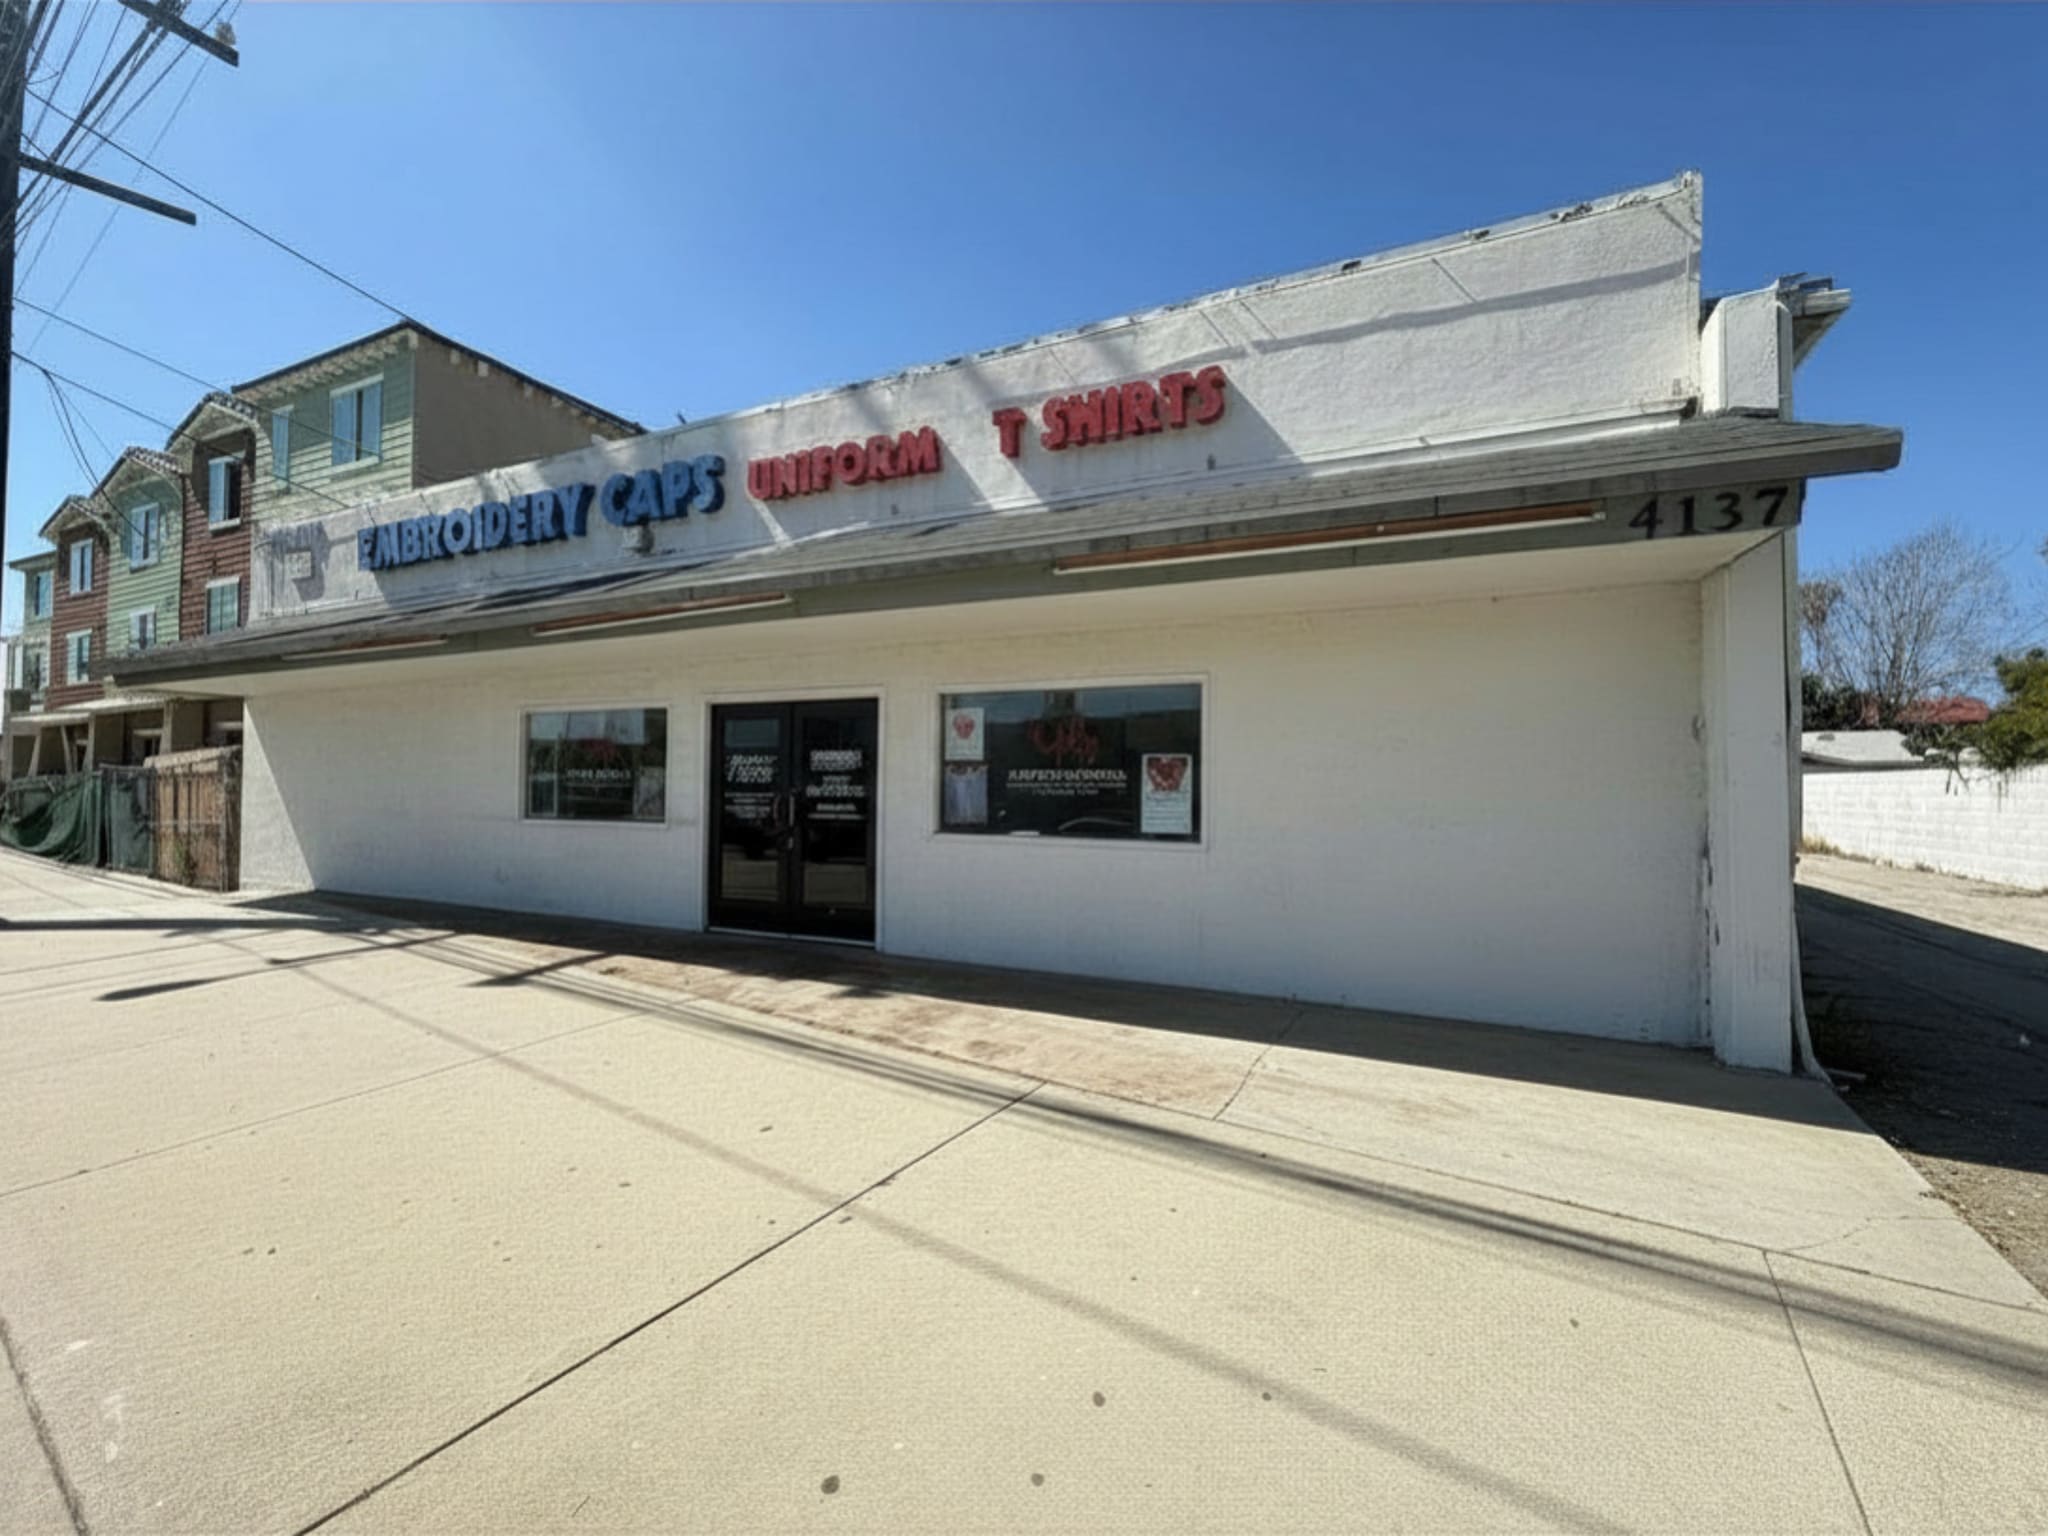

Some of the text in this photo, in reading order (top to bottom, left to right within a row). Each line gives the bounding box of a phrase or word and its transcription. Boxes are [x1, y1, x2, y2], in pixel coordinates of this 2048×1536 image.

[357, 365, 1226, 571] EMBROIDERY CAPS UNIFORM T SHIRTS
[1628, 487, 1789, 539] 4137
